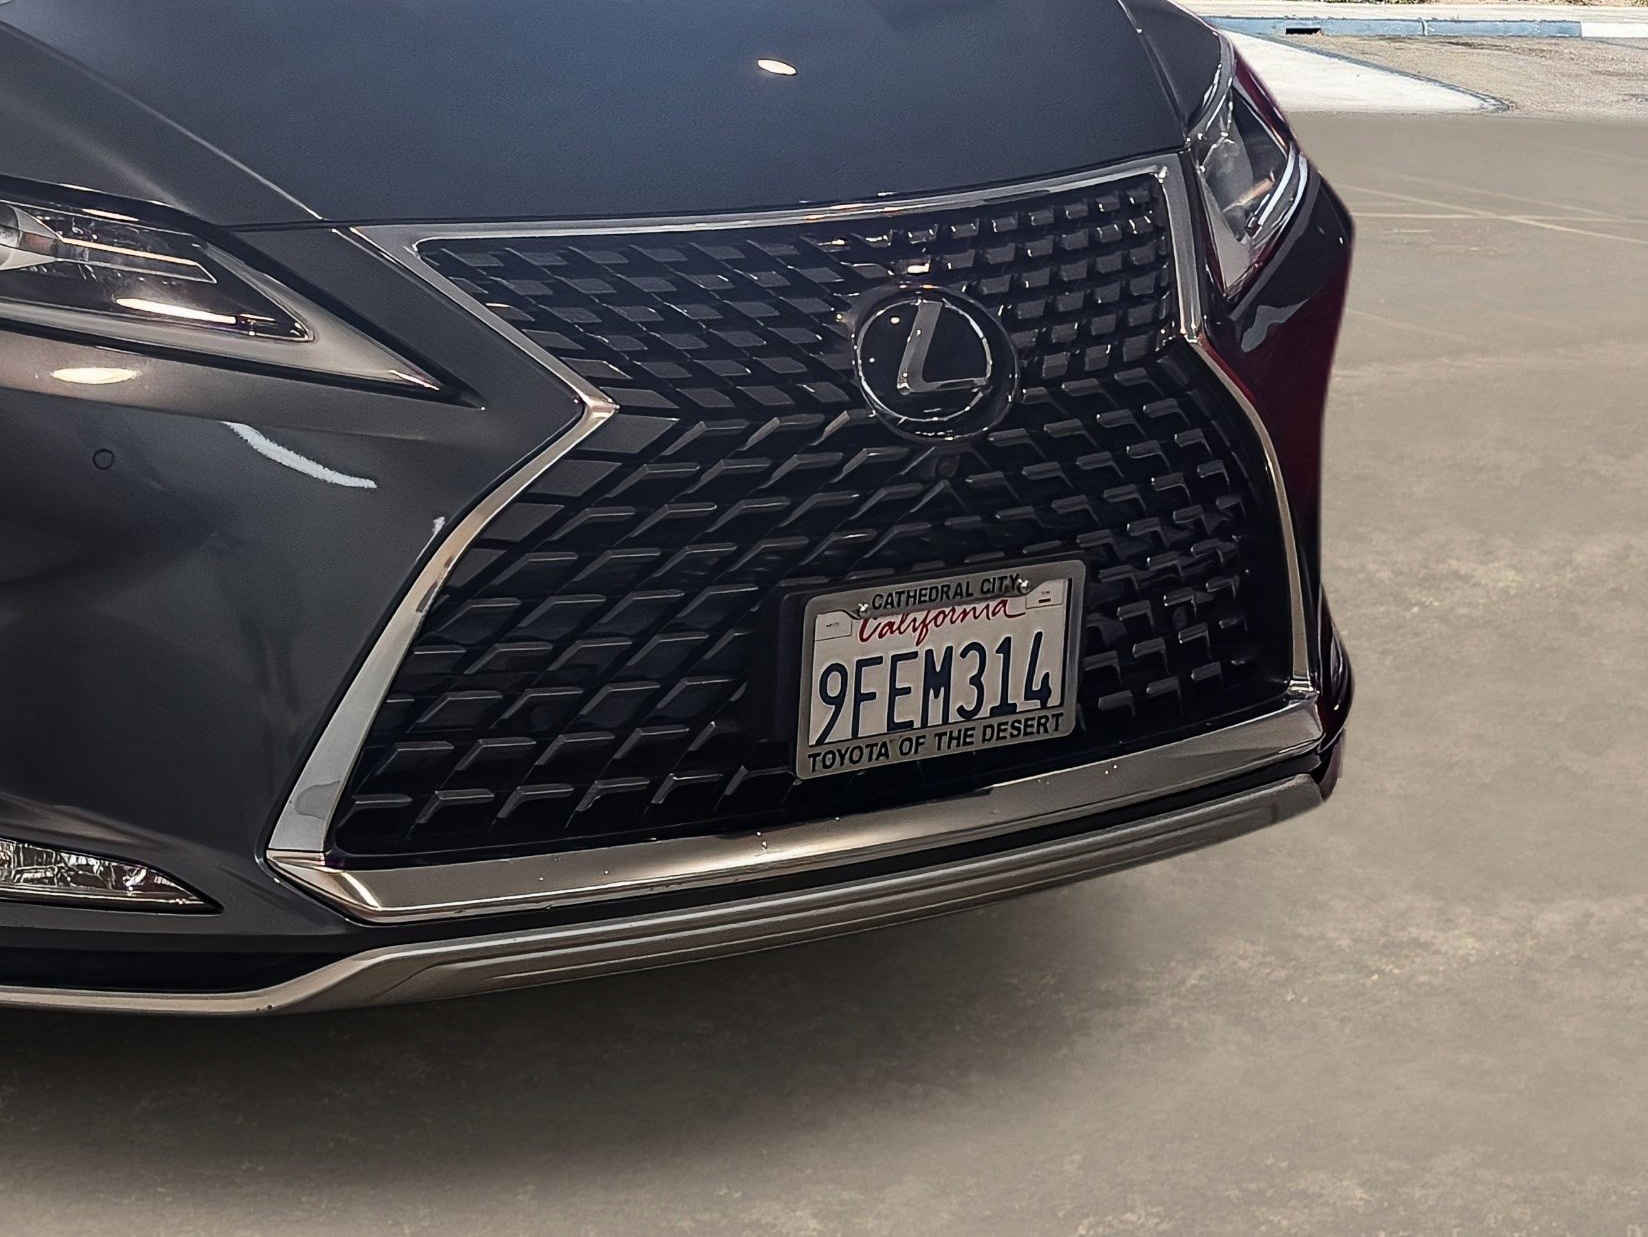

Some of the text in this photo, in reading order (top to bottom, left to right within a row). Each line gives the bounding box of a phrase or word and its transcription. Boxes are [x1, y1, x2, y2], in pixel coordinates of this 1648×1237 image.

[871, 573, 1020, 612] CATHEDRAL CITY
[858, 598, 1026, 646] California
[815, 630, 1053, 745] 9FEM314
[808, 712, 1065, 773] TOYOTA OF THE DESERT
